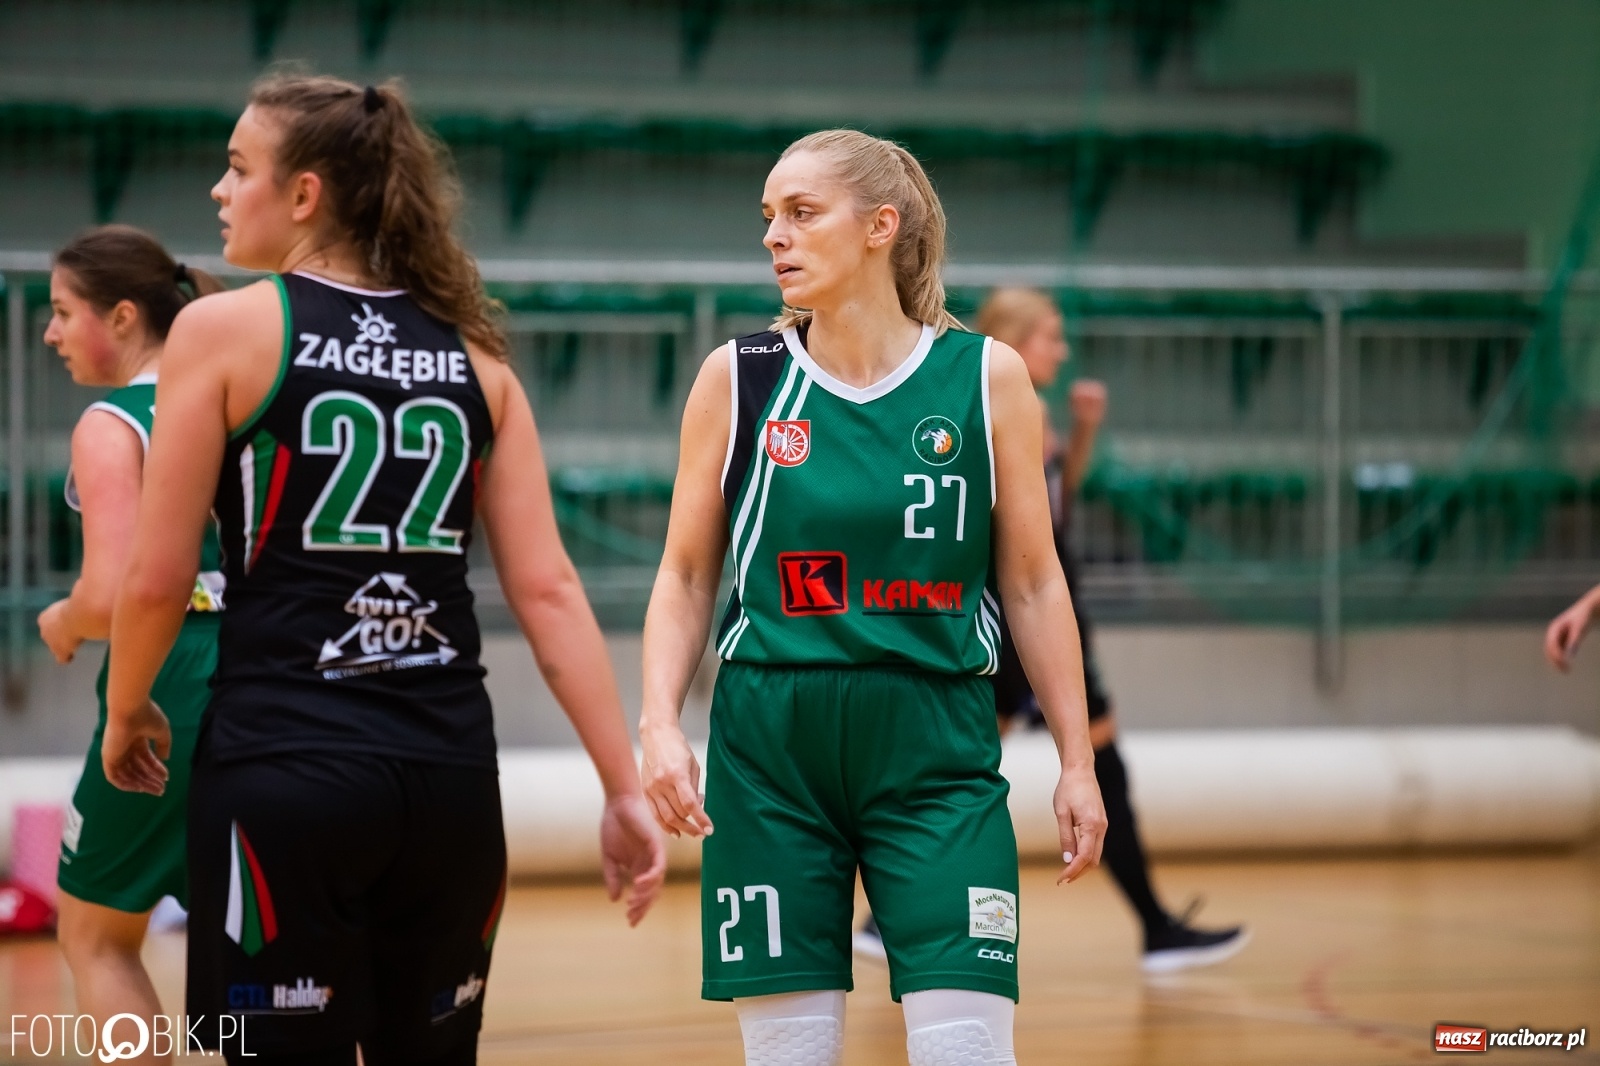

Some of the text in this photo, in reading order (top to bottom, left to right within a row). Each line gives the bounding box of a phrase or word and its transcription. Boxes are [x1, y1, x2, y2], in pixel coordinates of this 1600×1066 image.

[294, 333, 468, 390] ZAGŁĘBIE
[740, 342, 784, 354] COLO
[302, 390, 471, 554] 22
[904, 474, 967, 541] 27
[863, 579, 963, 611] KAMAN
[359, 615, 425, 655] GO!
[717, 885, 782, 962] 27
[975, 922, 1000, 932] Marcin
[977, 948, 1014, 964] COLO
